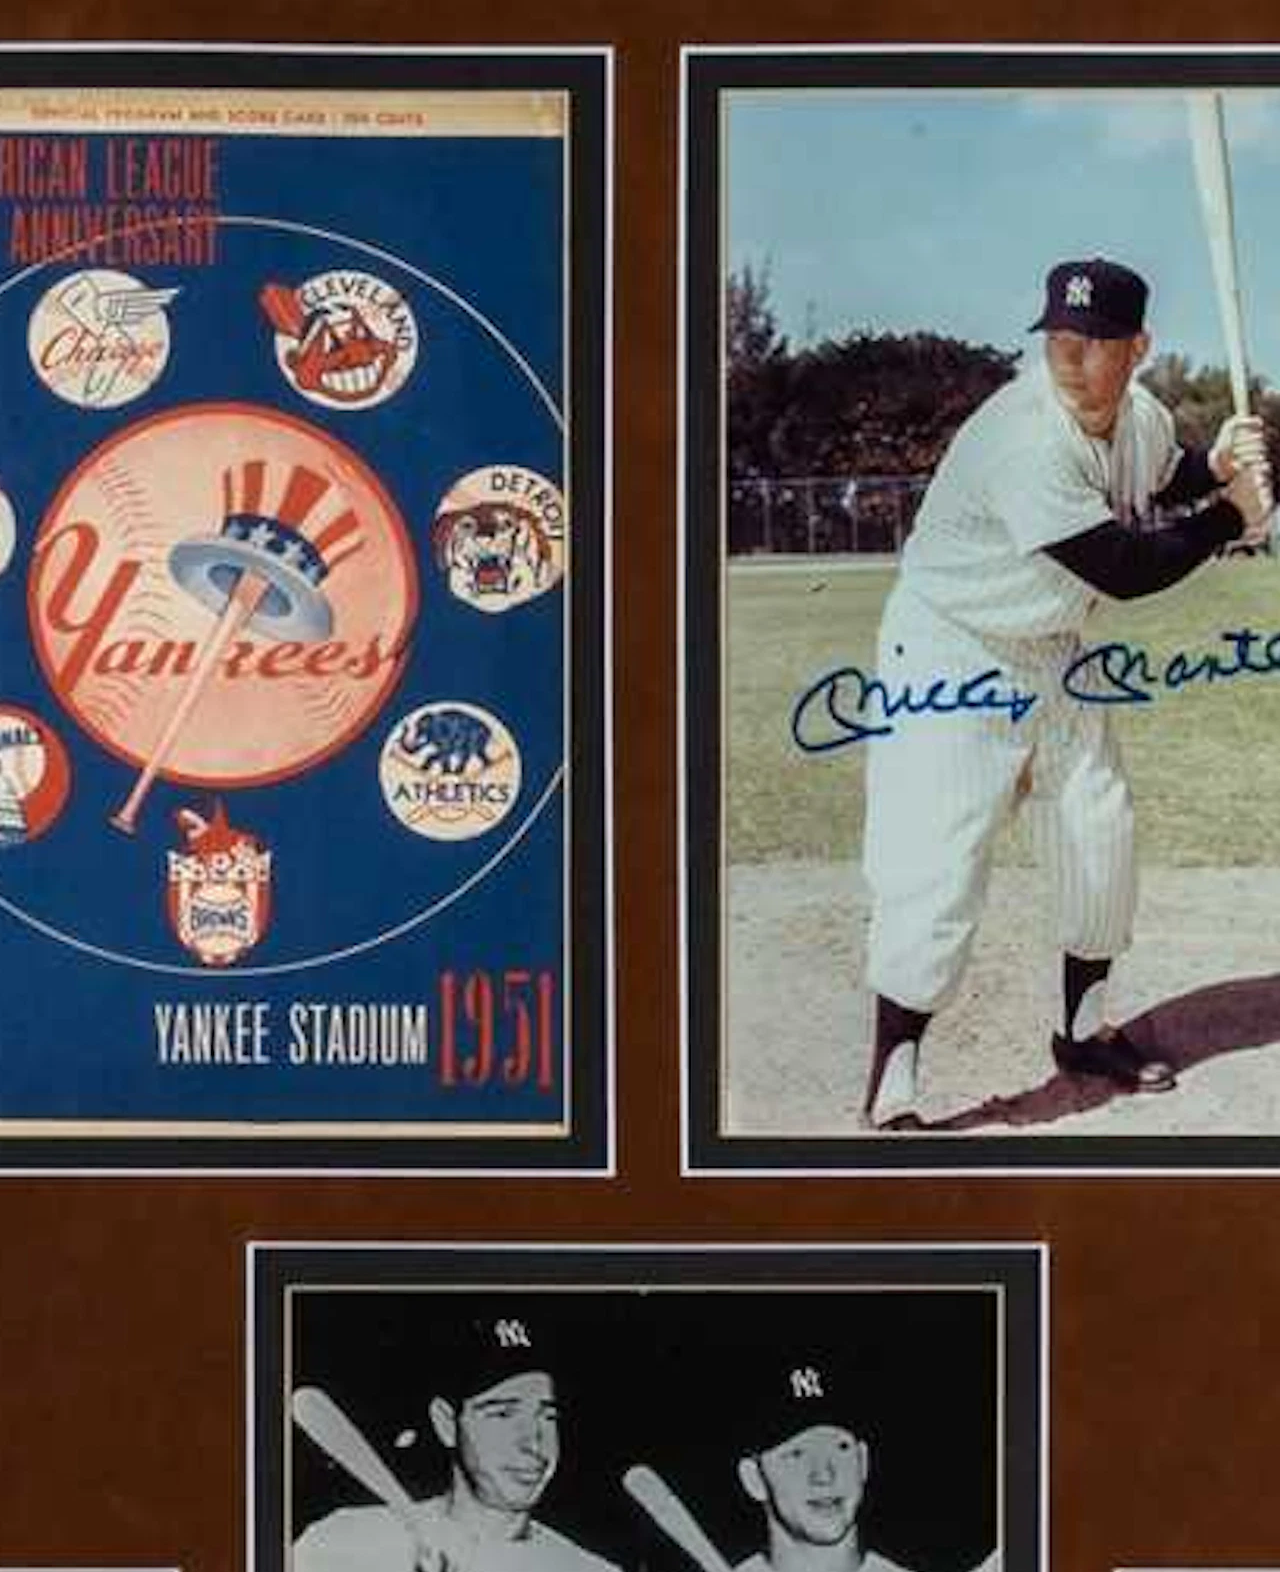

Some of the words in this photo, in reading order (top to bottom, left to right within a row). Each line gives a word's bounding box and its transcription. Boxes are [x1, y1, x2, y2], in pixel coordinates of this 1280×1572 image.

[107, 138, 220, 199] LEAGUE
[9, 204, 219, 266] ANNIVERSARY
[300, 276, 413, 352] CLEVELAND
[35, 522, 404, 696] Yankees
[791, 642, 1037, 752] Mickey
[393, 781, 510, 805] ATHLETICS
[190, 904, 248, 931] BROWNS
[155, 1002, 271, 1065] YANKEE
[289, 1002, 429, 1065] STADIUM
[438, 969, 556, 1094] 1951
